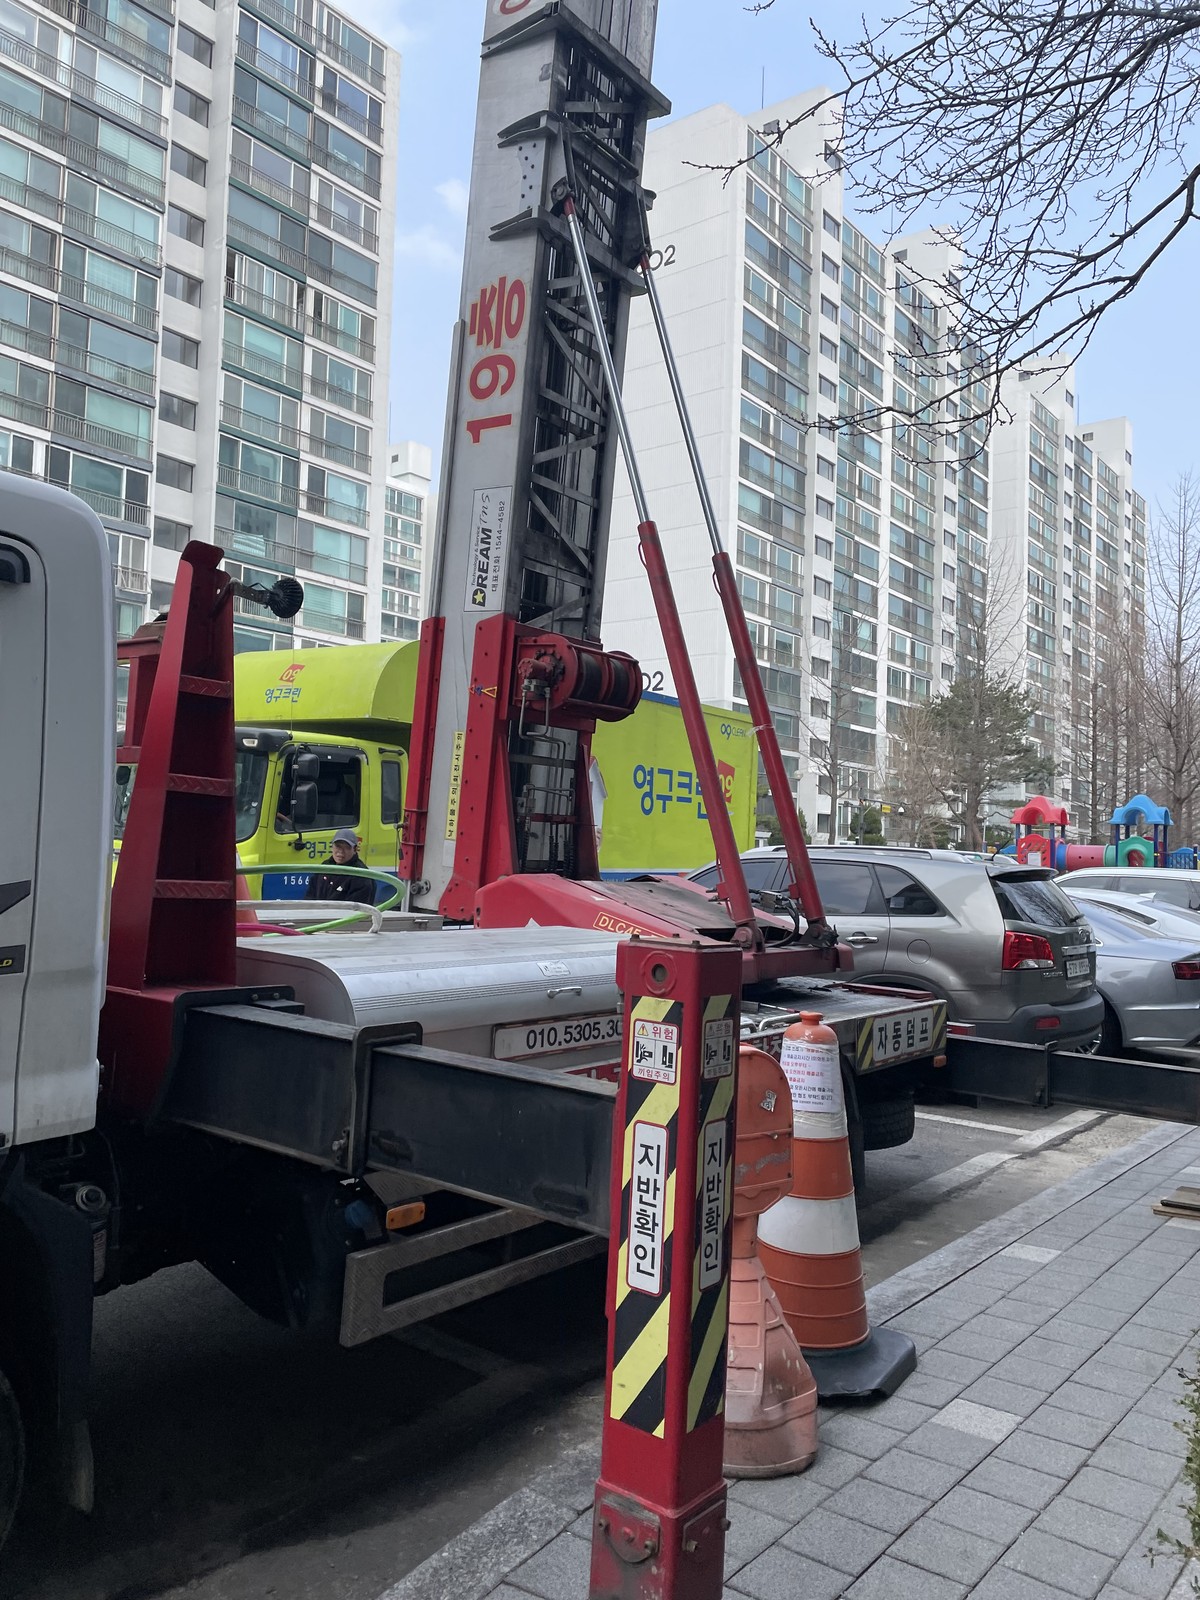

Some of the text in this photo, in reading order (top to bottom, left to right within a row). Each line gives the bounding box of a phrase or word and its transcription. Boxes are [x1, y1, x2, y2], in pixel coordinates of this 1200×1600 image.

[466, 275, 526, 444] 19층
[472, 527, 492, 608] DREAM
[491, 501, 506, 593] 대표전화 1544-4582
[264, 687, 302, 704] 영구크린
[283, 876, 310, 885] 1566
[652, 1026, 674, 1040] 위험
[877, 1017, 929, 1055] 자동덤프
[637, 1068, 670, 1082] 끼임주의
[634, 1143, 661, 1277] 지반확인
[703, 1138, 723, 1272] 지반확인
